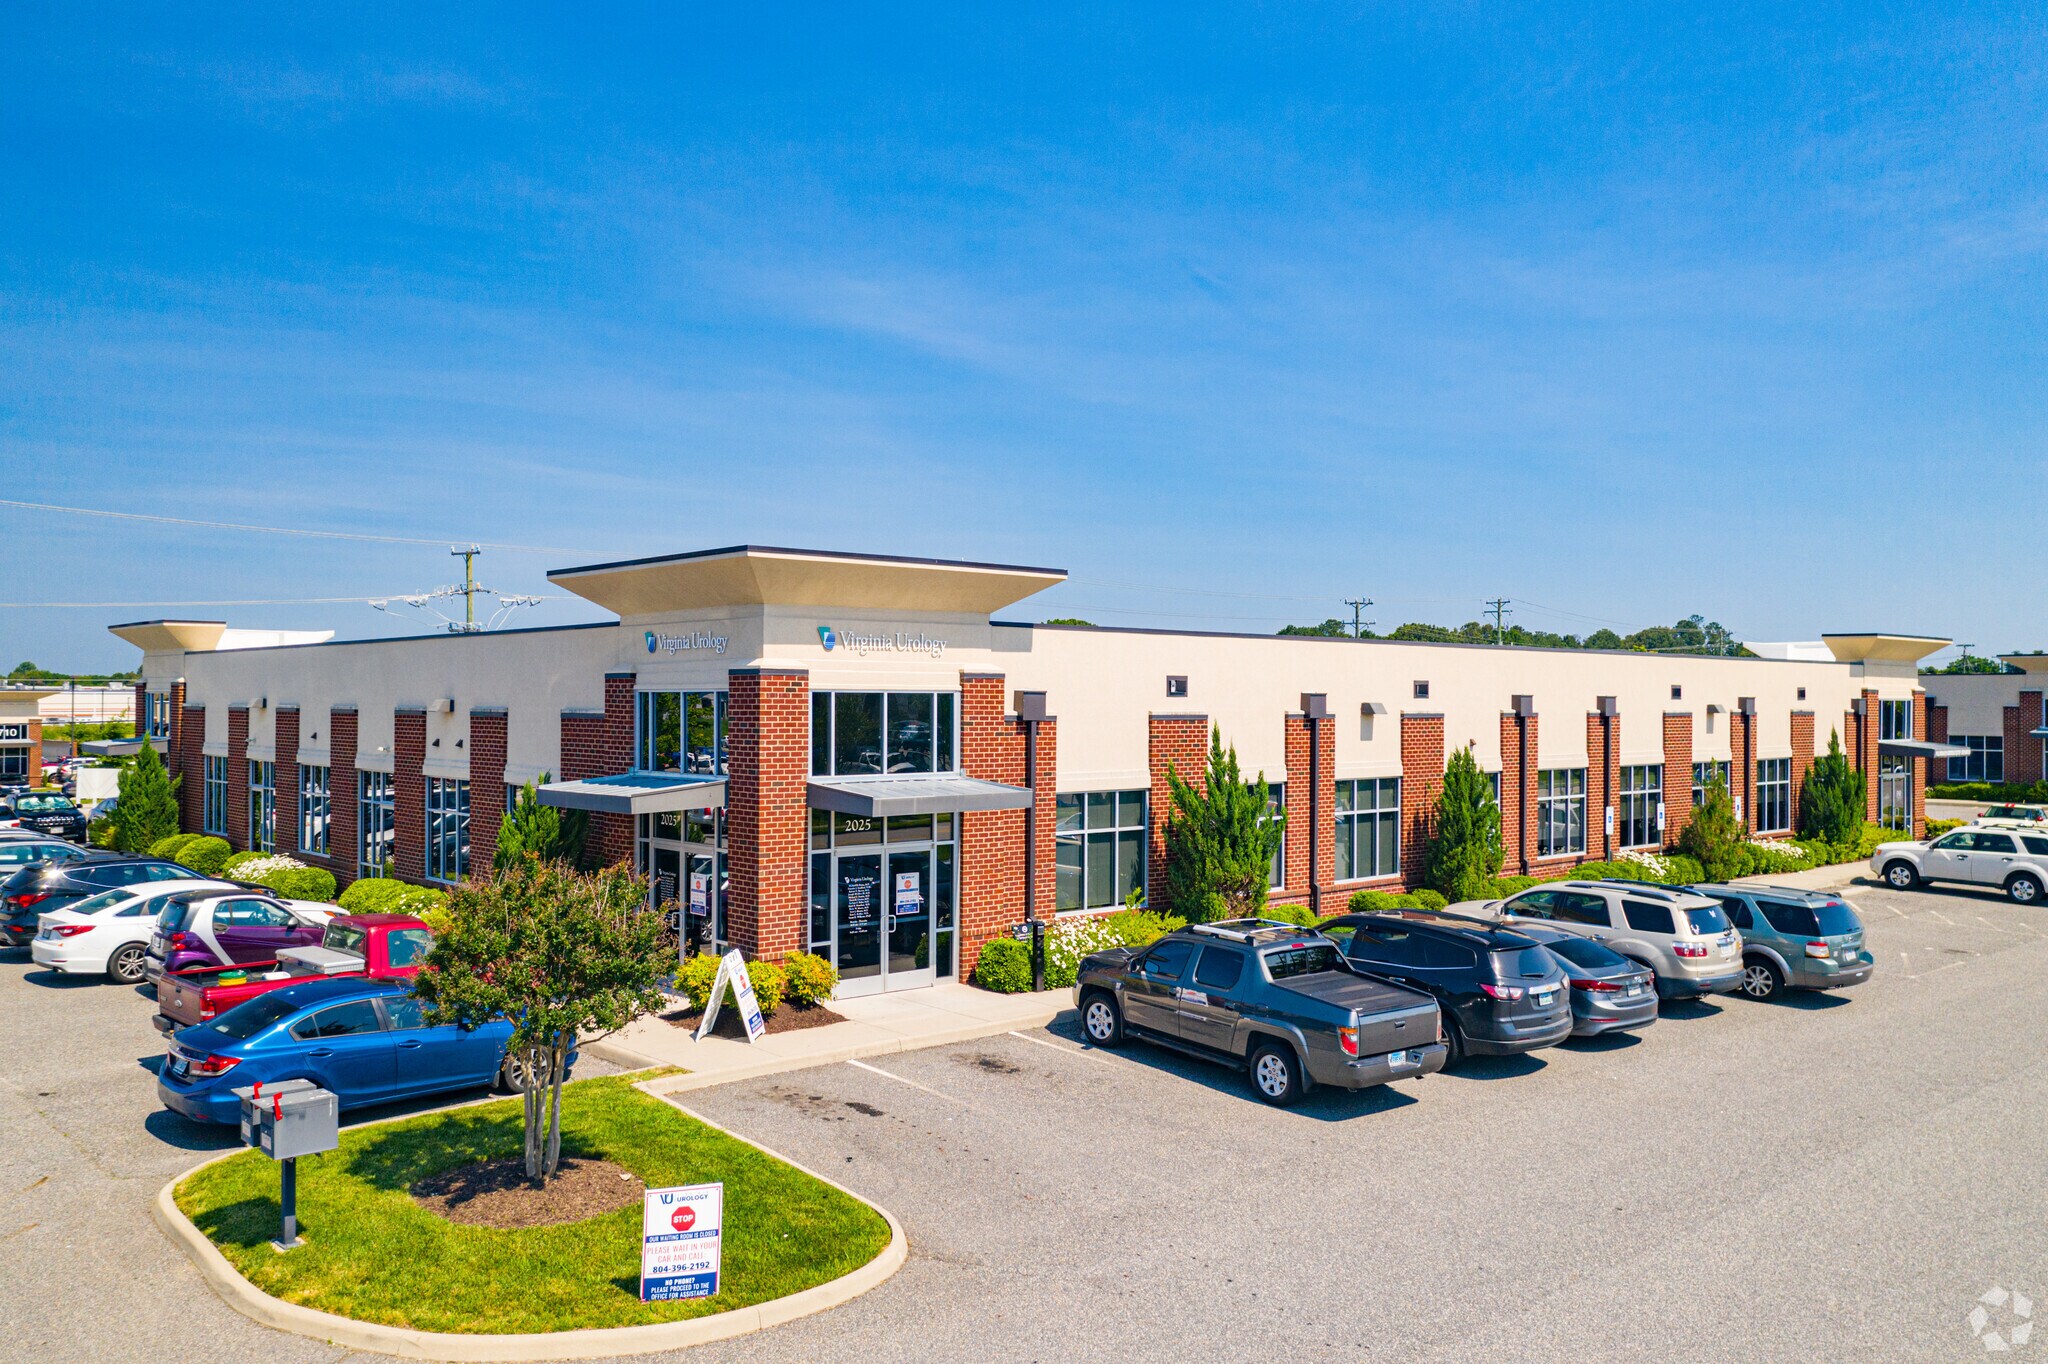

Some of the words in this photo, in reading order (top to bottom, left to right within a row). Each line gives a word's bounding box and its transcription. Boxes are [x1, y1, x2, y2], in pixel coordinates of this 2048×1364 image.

[657, 633, 690, 656] Virginia
[691, 630, 728, 654] Urology
[839, 630, 893, 656] Virginia
[895, 632, 947, 658] Urology
[660, 813, 677, 827] 2025
[845, 818, 871, 832] 2025
[677, 1194, 708, 1202] UROLOGY
[673, 1215, 693, 1223] STOP
[647, 1245, 670, 1254] PLEASE
[672, 1243, 688, 1252] WAIT
[691, 1242, 698, 1251] IN
[700, 1241, 717, 1249] YOUR
[658, 1255, 671, 1263] CAR
[673, 1253, 687, 1261] AND
[652, 1261, 710, 1273] 804-396-2192
[674, 1277, 696, 1285] PHONE?
[670, 1284, 692, 1292] PROCEED
[669, 1291, 679, 1299] FOR
[680, 1289, 709, 1298] ASSISTANCE
